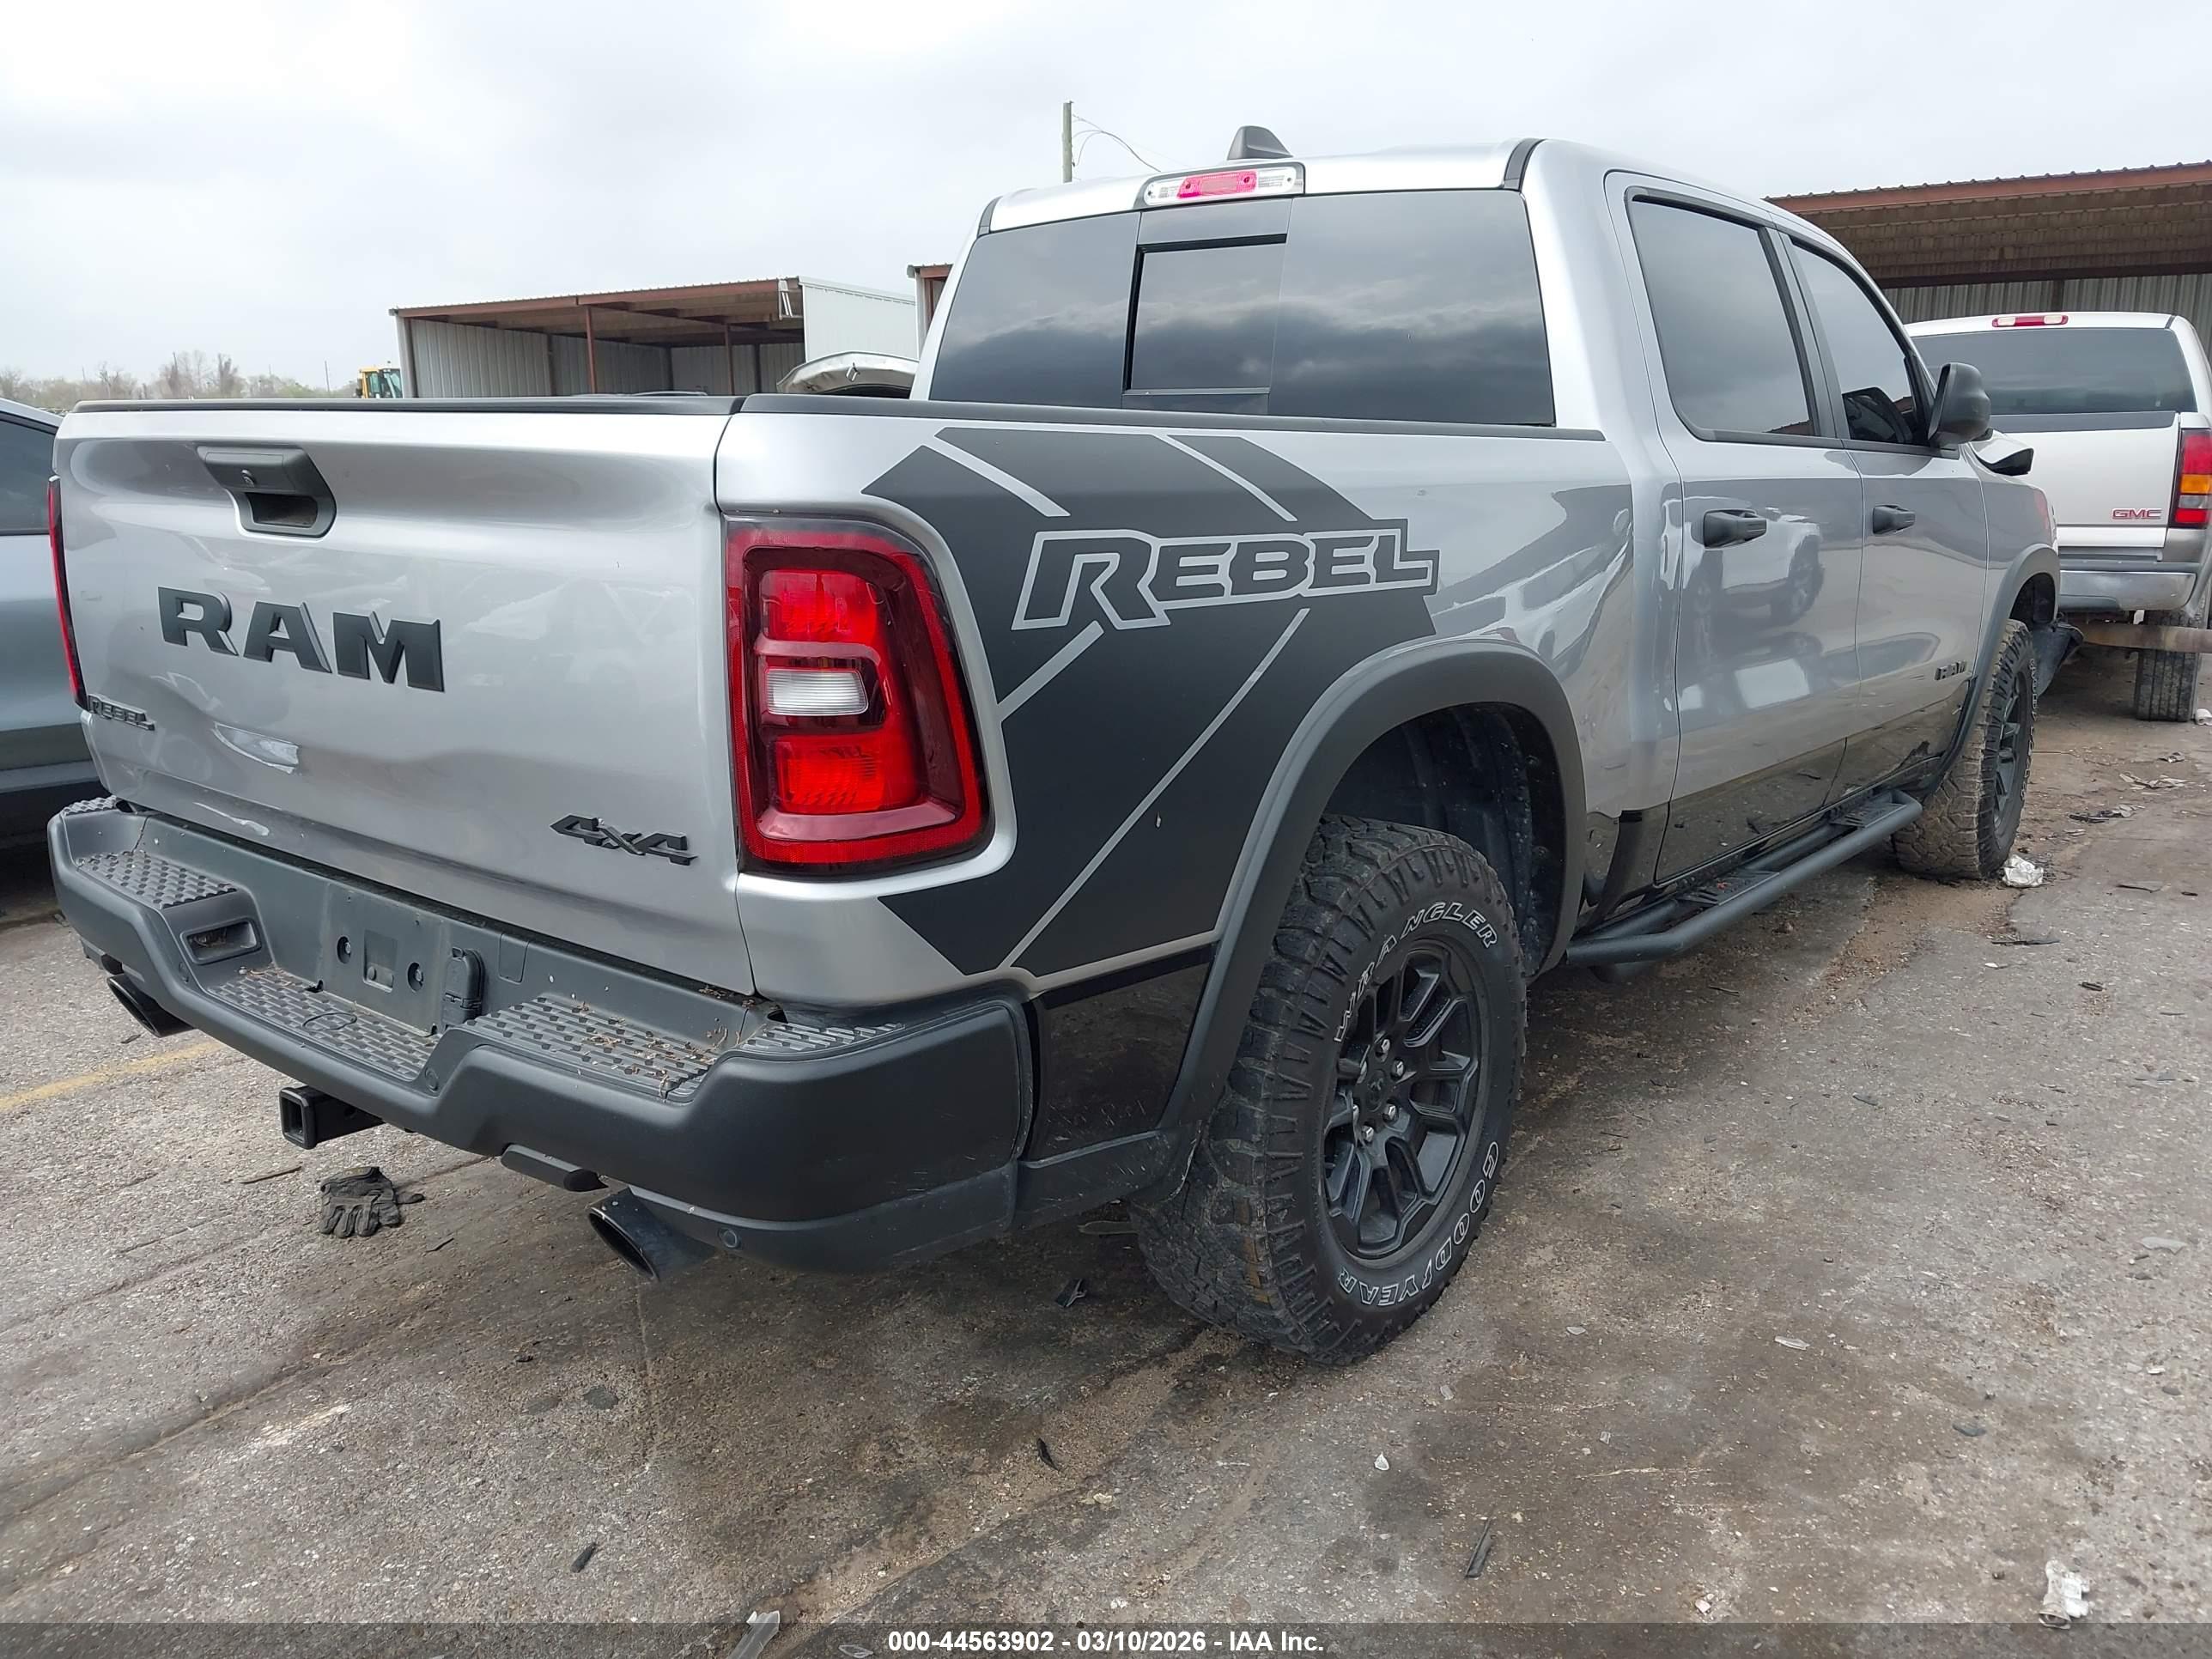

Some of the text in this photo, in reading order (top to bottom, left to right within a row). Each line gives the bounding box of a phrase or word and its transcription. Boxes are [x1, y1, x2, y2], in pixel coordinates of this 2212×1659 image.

[2112, 508, 2162, 520] GMC
[1012, 529, 1435, 631] REBEL
[158, 587, 444, 692] RAM
[88, 694, 155, 732] REBEL
[1334, 902, 1498, 1042] WRANGLER
